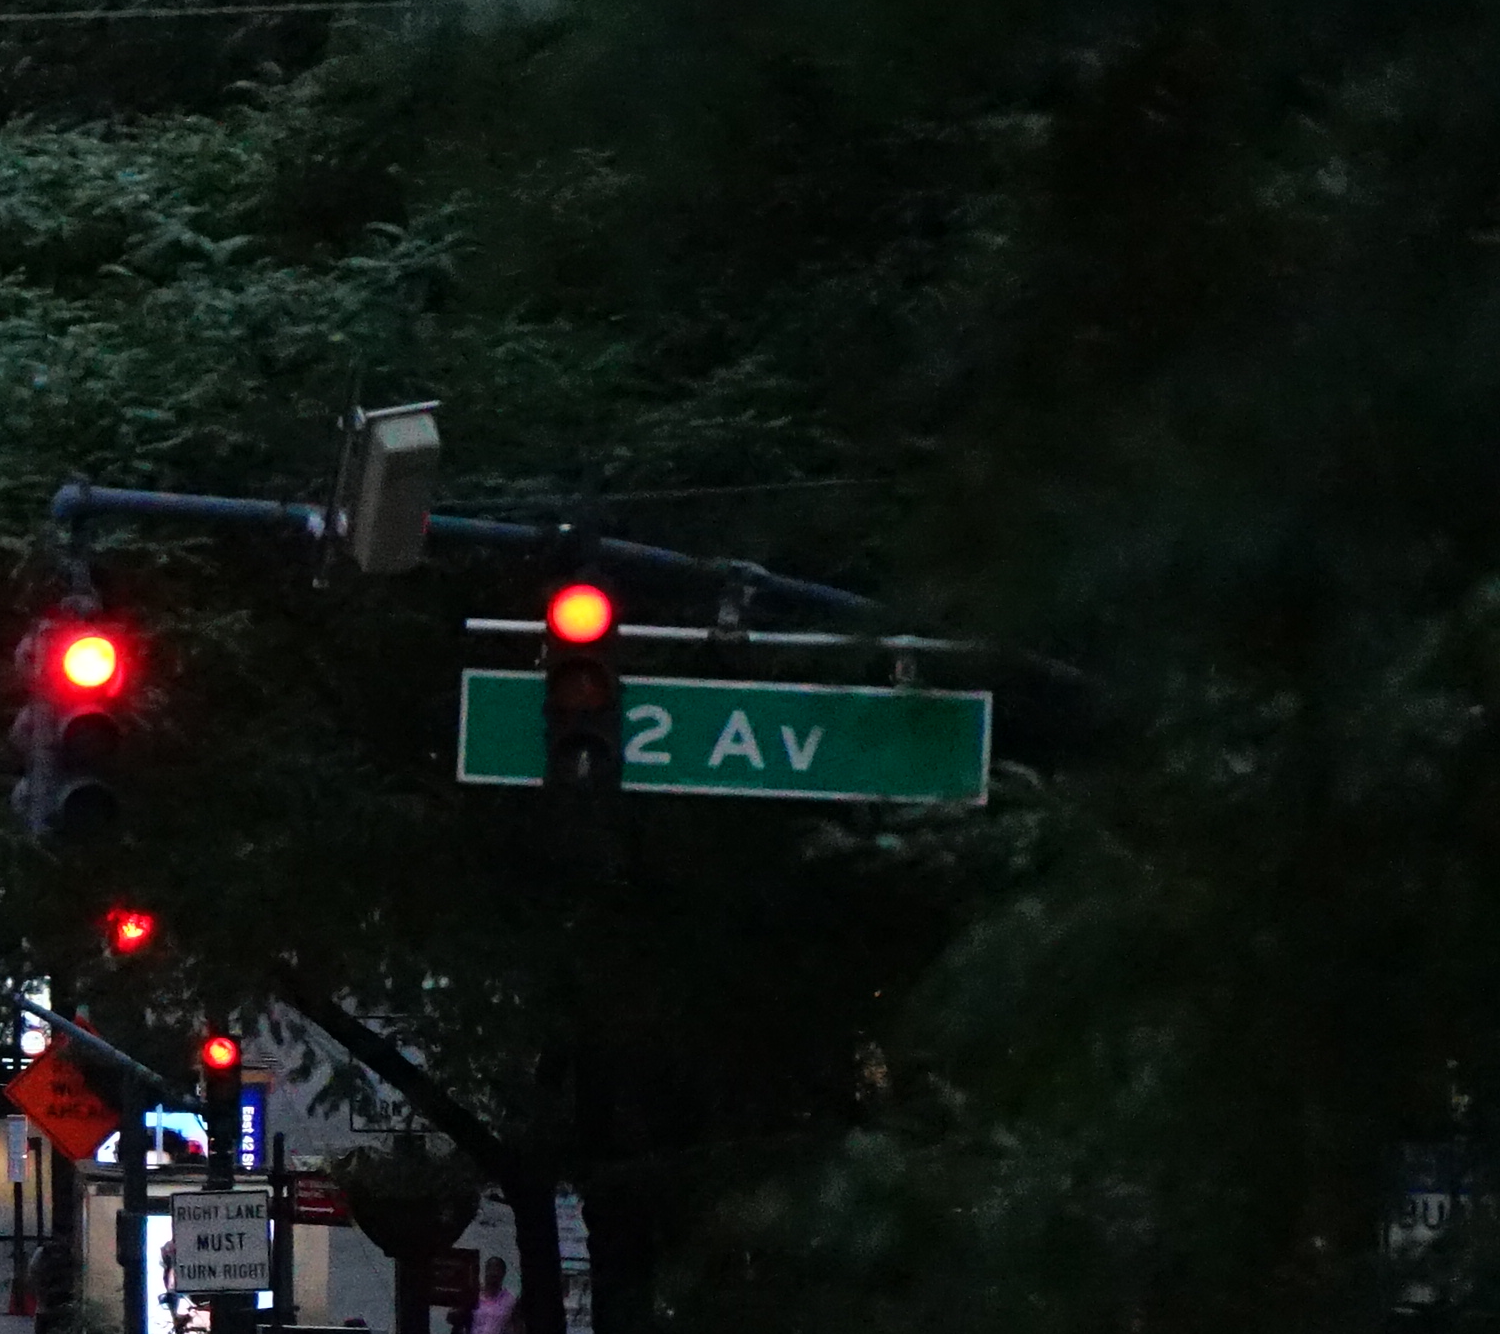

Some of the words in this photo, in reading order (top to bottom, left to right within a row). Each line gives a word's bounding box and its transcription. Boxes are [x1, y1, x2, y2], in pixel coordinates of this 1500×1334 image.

[624, 704, 673, 764] 2
[708, 710, 825, 771] Av
[241, 1106, 255, 1134] East
[241, 1135, 255, 1151] 42
[177, 1206, 219, 1221] RIGHT
[226, 1204, 265, 1220] LANE
[196, 1232, 246, 1252] MUST
[179, 1264, 217, 1280] TURN
[223, 1263, 267, 1280] RIGHT
